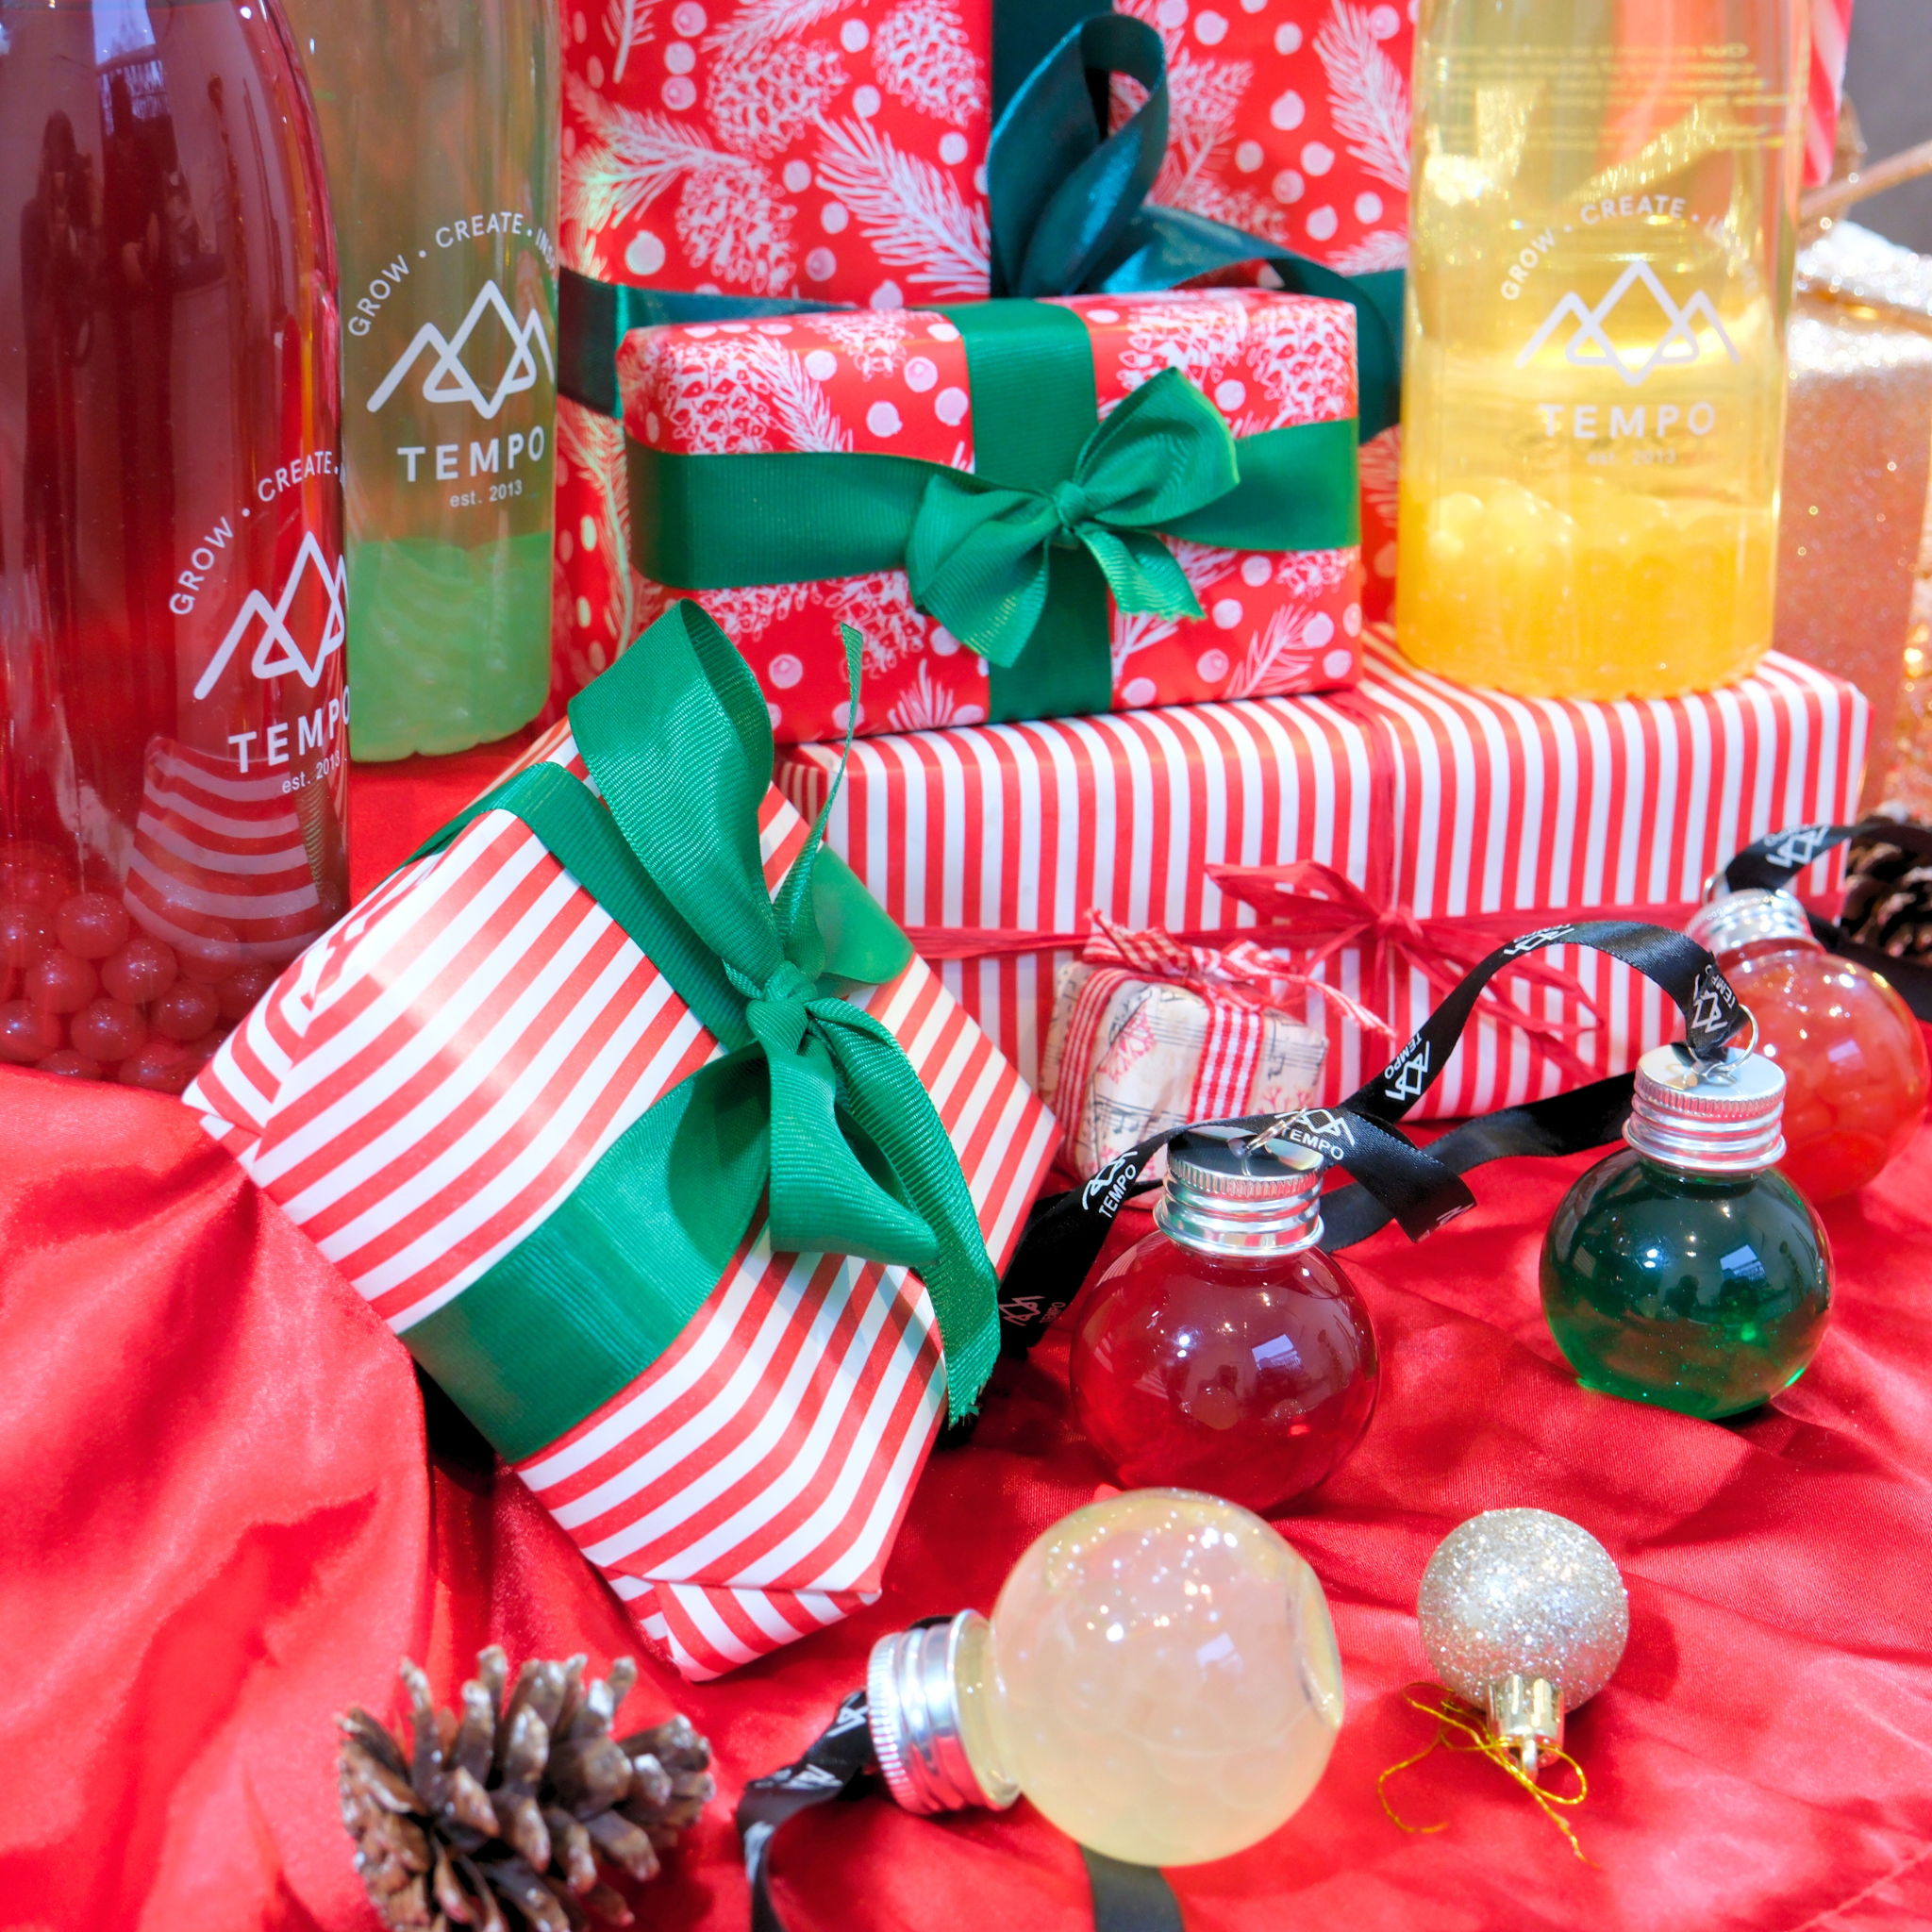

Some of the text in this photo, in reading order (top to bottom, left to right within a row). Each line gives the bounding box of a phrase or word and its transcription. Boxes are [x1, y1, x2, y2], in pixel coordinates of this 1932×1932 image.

[348, 255, 409, 336] GROW
[435, 211, 525, 248] CREATE
[1500, 194, 1687, 301] GROW CREATE
[1538, 401, 1716, 440] TEMPO
[397, 425, 545, 482] TEMPO
[450, 479, 523, 508] est. 2013
[169, 517, 234, 614] GROW
[258, 451, 332, 502] CREATE
[228, 685, 350, 774] TEMPO
[282, 750, 340, 793] est. 2013
[1384, 1031, 1423, 1080] TEMPO
[1099, 1164, 1137, 1219] TEMPO
